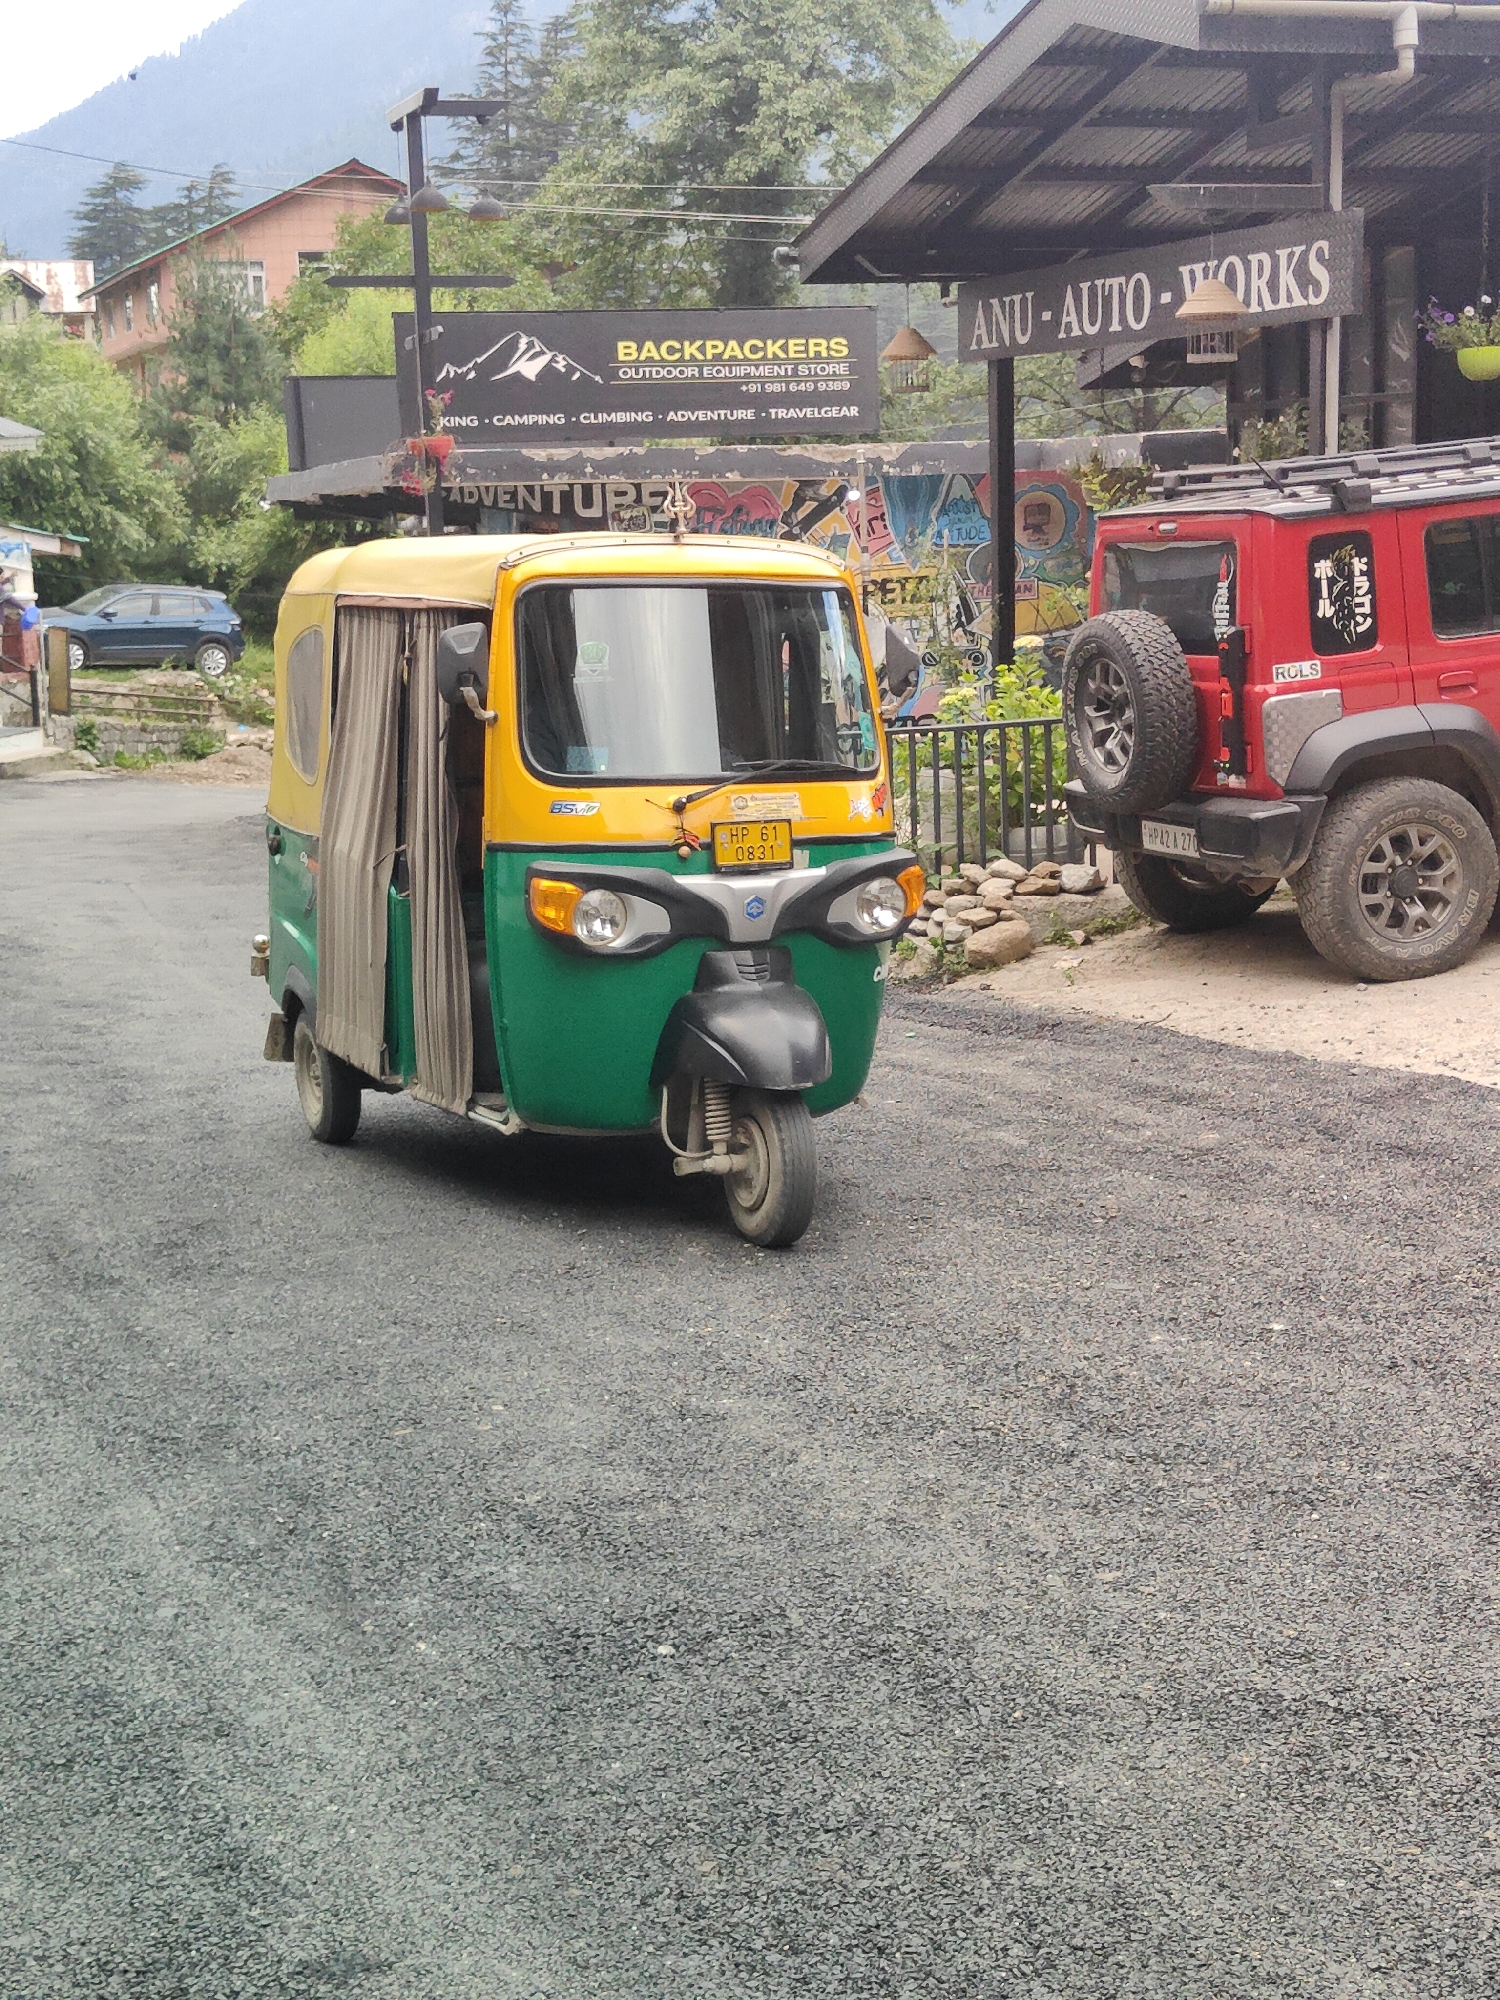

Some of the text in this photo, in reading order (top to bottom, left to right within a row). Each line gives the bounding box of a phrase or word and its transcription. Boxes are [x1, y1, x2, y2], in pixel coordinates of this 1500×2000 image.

[969, 291, 1035, 350] ANU
[1058, 272, 1152, 340] AUTO
[616, 337, 849, 361] BACKPACKERS
[618, 363, 850, 379] OUTDOOR EQUIPMENT STORE
[740, 381, 850, 394] +91 981 649 9389
[439, 406, 859, 428] KING CAMPING CLIMBING ADVENTURE TRAVELGEAR
[1314, 559, 1336, 618] ボール
[1351, 556, 1373, 633] ドラゴン
[1274, 663, 1319, 681] ROLS
[730, 825, 777, 843] HP 61
[736, 844, 774, 861] 0831
[1419, 889, 1480, 957] BRAVO
